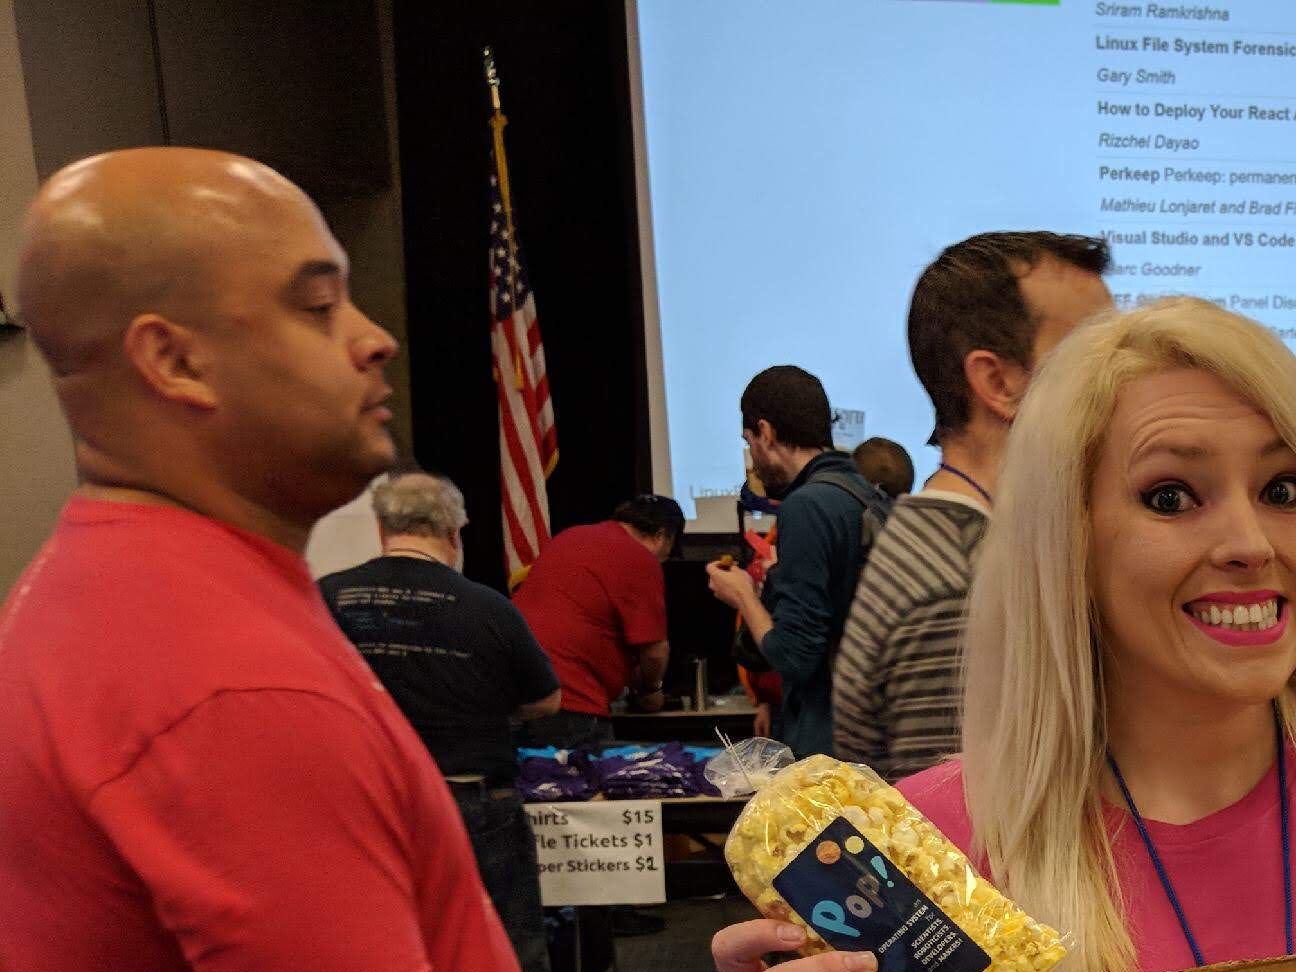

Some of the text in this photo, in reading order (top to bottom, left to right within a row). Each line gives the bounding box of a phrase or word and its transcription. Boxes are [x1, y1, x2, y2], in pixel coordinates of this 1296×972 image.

[1095, 2, 1230, 21] Sriram Ramkrishna
[1095, 35, 1138, 51] Linux
[1142, 37, 1170, 52] File
[1174, 38, 1229, 56] System
[1096, 68, 1175, 86] Gary Smith
[1097, 101, 1131, 117] How
[1134, 103, 1150, 117] to
[1154, 103, 1206, 121] Deploy
[1209, 104, 1243, 120] Your
[1248, 106, 1289, 121] React
[1099, 133, 1200, 152] Rizchel Dayao
[1099, 166, 1160, 184] Perkeep
[1164, 167, 1226, 184] Perkeep:
[1100, 198, 1156, 214] Mathieu
[1160, 199, 1216, 217] Lonjaret
[1219, 201, 1245, 215] and
[1249, 201, 1281, 216] Brad
[1101, 230, 1147, 246] Visual
[1151, 231, 1198, 246] Studio
[1202, 232, 1229, 247] and
[1233, 232, 1254, 247] VS
[1258, 234, 1294, 248] Code
[1141, 262, 1201, 276] Goodner
[1230, 296, 1270, 311] Panel
[622, 808, 654, 826] $15
[561, 834, 628, 850] Tickets
[634, 832, 652, 849] $1
[567, 858, 630, 873] Stickers
[878, 904, 929, 954] OPERATING SYSTEM
